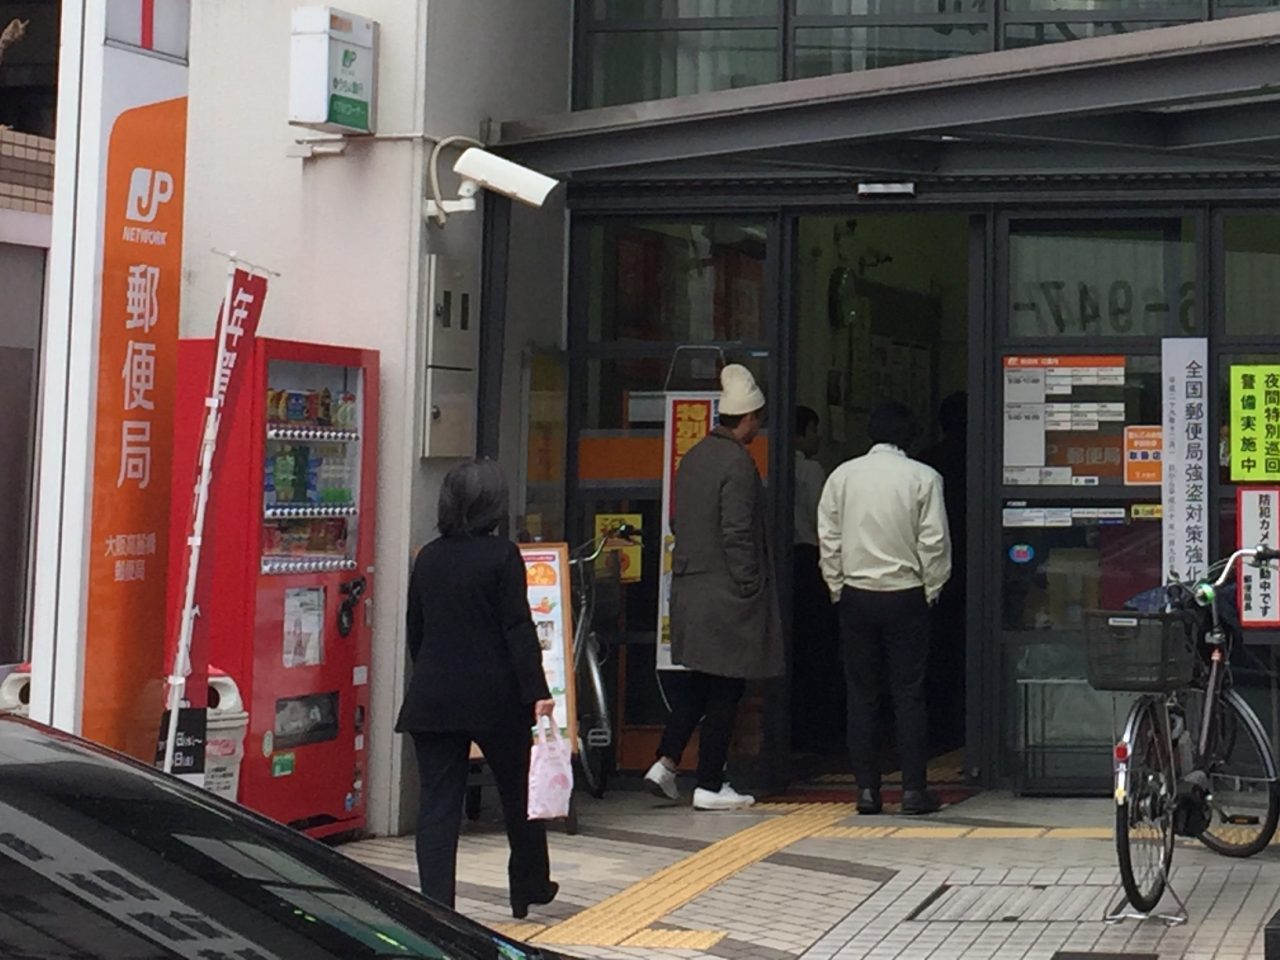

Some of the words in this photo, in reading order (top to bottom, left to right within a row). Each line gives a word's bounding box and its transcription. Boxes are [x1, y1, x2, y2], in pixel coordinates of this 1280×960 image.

[122, 226, 168, 246] NETWORK
[115, 263, 161, 490] 郵便局
[1240, 373, 1257, 474] 警備実施中
[1264, 372, 1280, 474] 夜間特別巡回
[1258, 493, 1271, 617] 防犯カメ動中です
